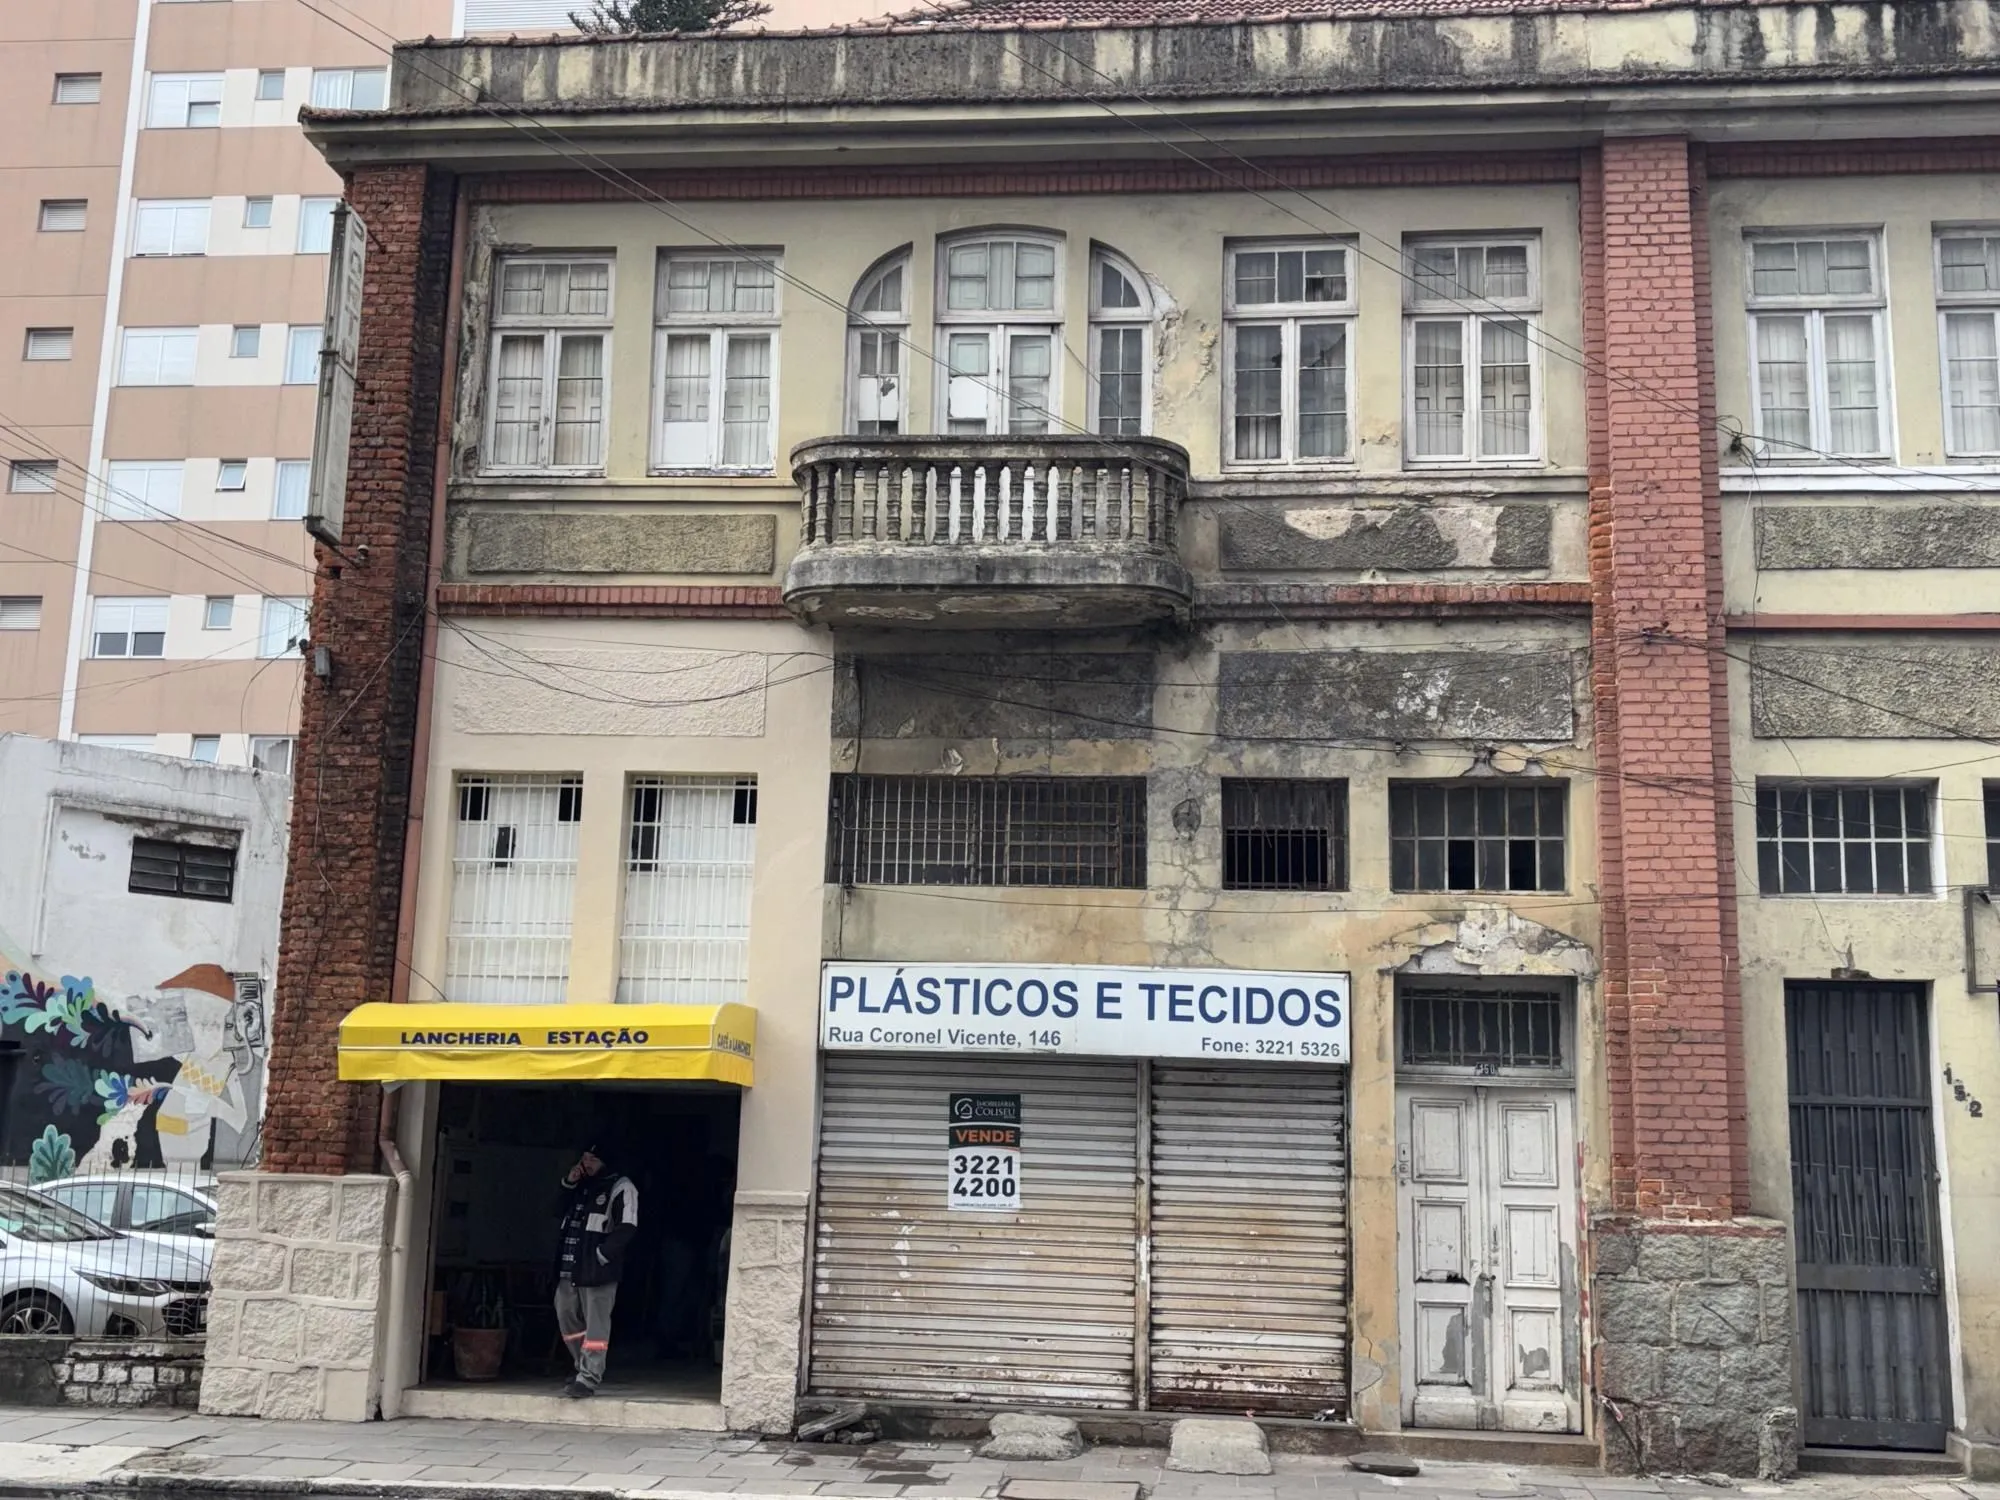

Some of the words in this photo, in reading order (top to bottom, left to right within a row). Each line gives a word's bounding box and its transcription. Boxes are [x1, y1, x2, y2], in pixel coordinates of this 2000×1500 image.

[829, 968, 1079, 1018] PLÁSTICOS
[1096, 981, 1122, 1020] E
[1138, 983, 1342, 1028] TECIDOS
[401, 1032, 522, 1045] LANCHERIA
[547, 1027, 649, 1047] ESTAÇÃO
[829, 1026, 864, 1042] Rua
[869, 1028, 941, 1044] Coronel
[947, 1030, 1022, 1048] Vicente,
[1031, 1030, 1061, 1046] 146
[1202, 1037, 1250, 1053] Fone:
[1255, 1040, 1294, 1055] 3221
[1300, 1042, 1341, 1057] 5326
[1479, 1063, 1495, 1075] 150
[975, 1106, 1015, 1116] COLISEU
[956, 1129, 1015, 1142] VENDE
[954, 1155, 1013, 1174] 3221
[953, 1177, 1015, 1197] 4200
